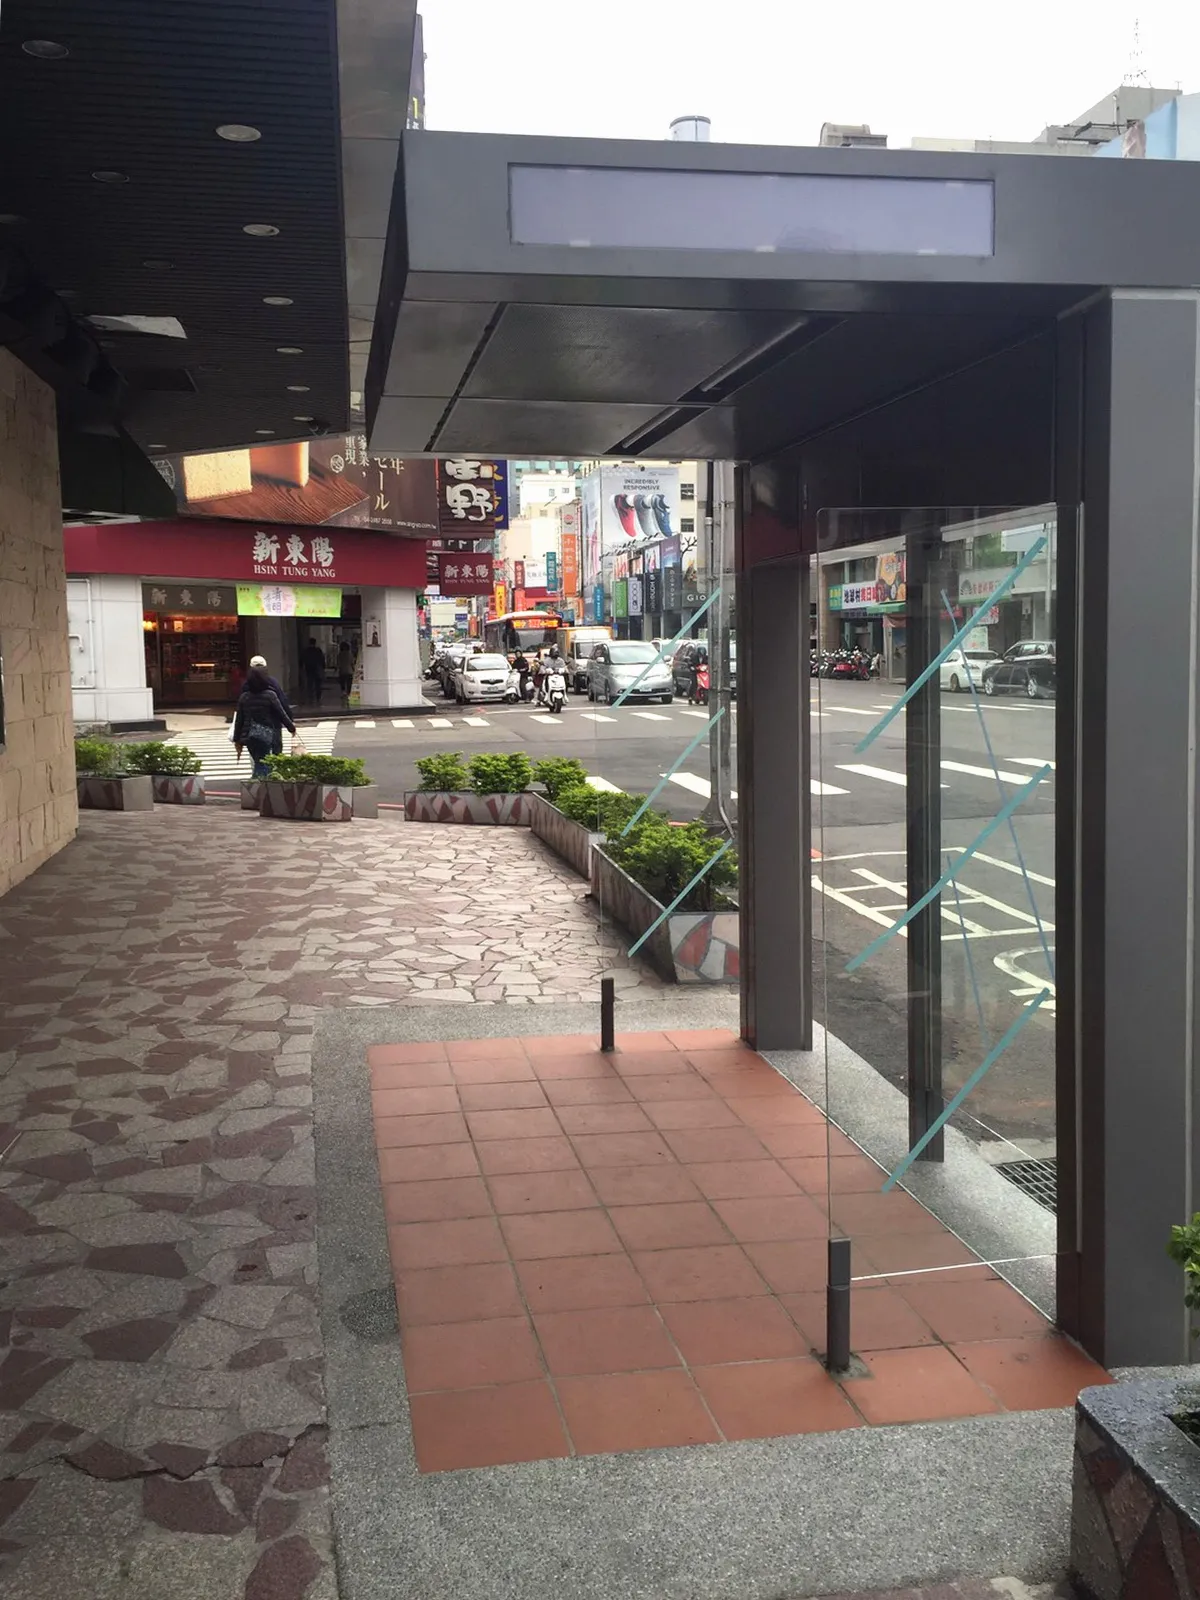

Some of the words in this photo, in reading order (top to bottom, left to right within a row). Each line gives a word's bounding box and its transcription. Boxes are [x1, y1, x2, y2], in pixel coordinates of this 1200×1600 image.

[253, 531, 334, 567] 新東陽
[254, 565, 277, 575] HSIN
[282, 566, 308, 577] TUNG
[312, 568, 335, 577] YANG
[445, 564, 489, 578] 新東陽
[151, 587, 222, 607] 新東陽
